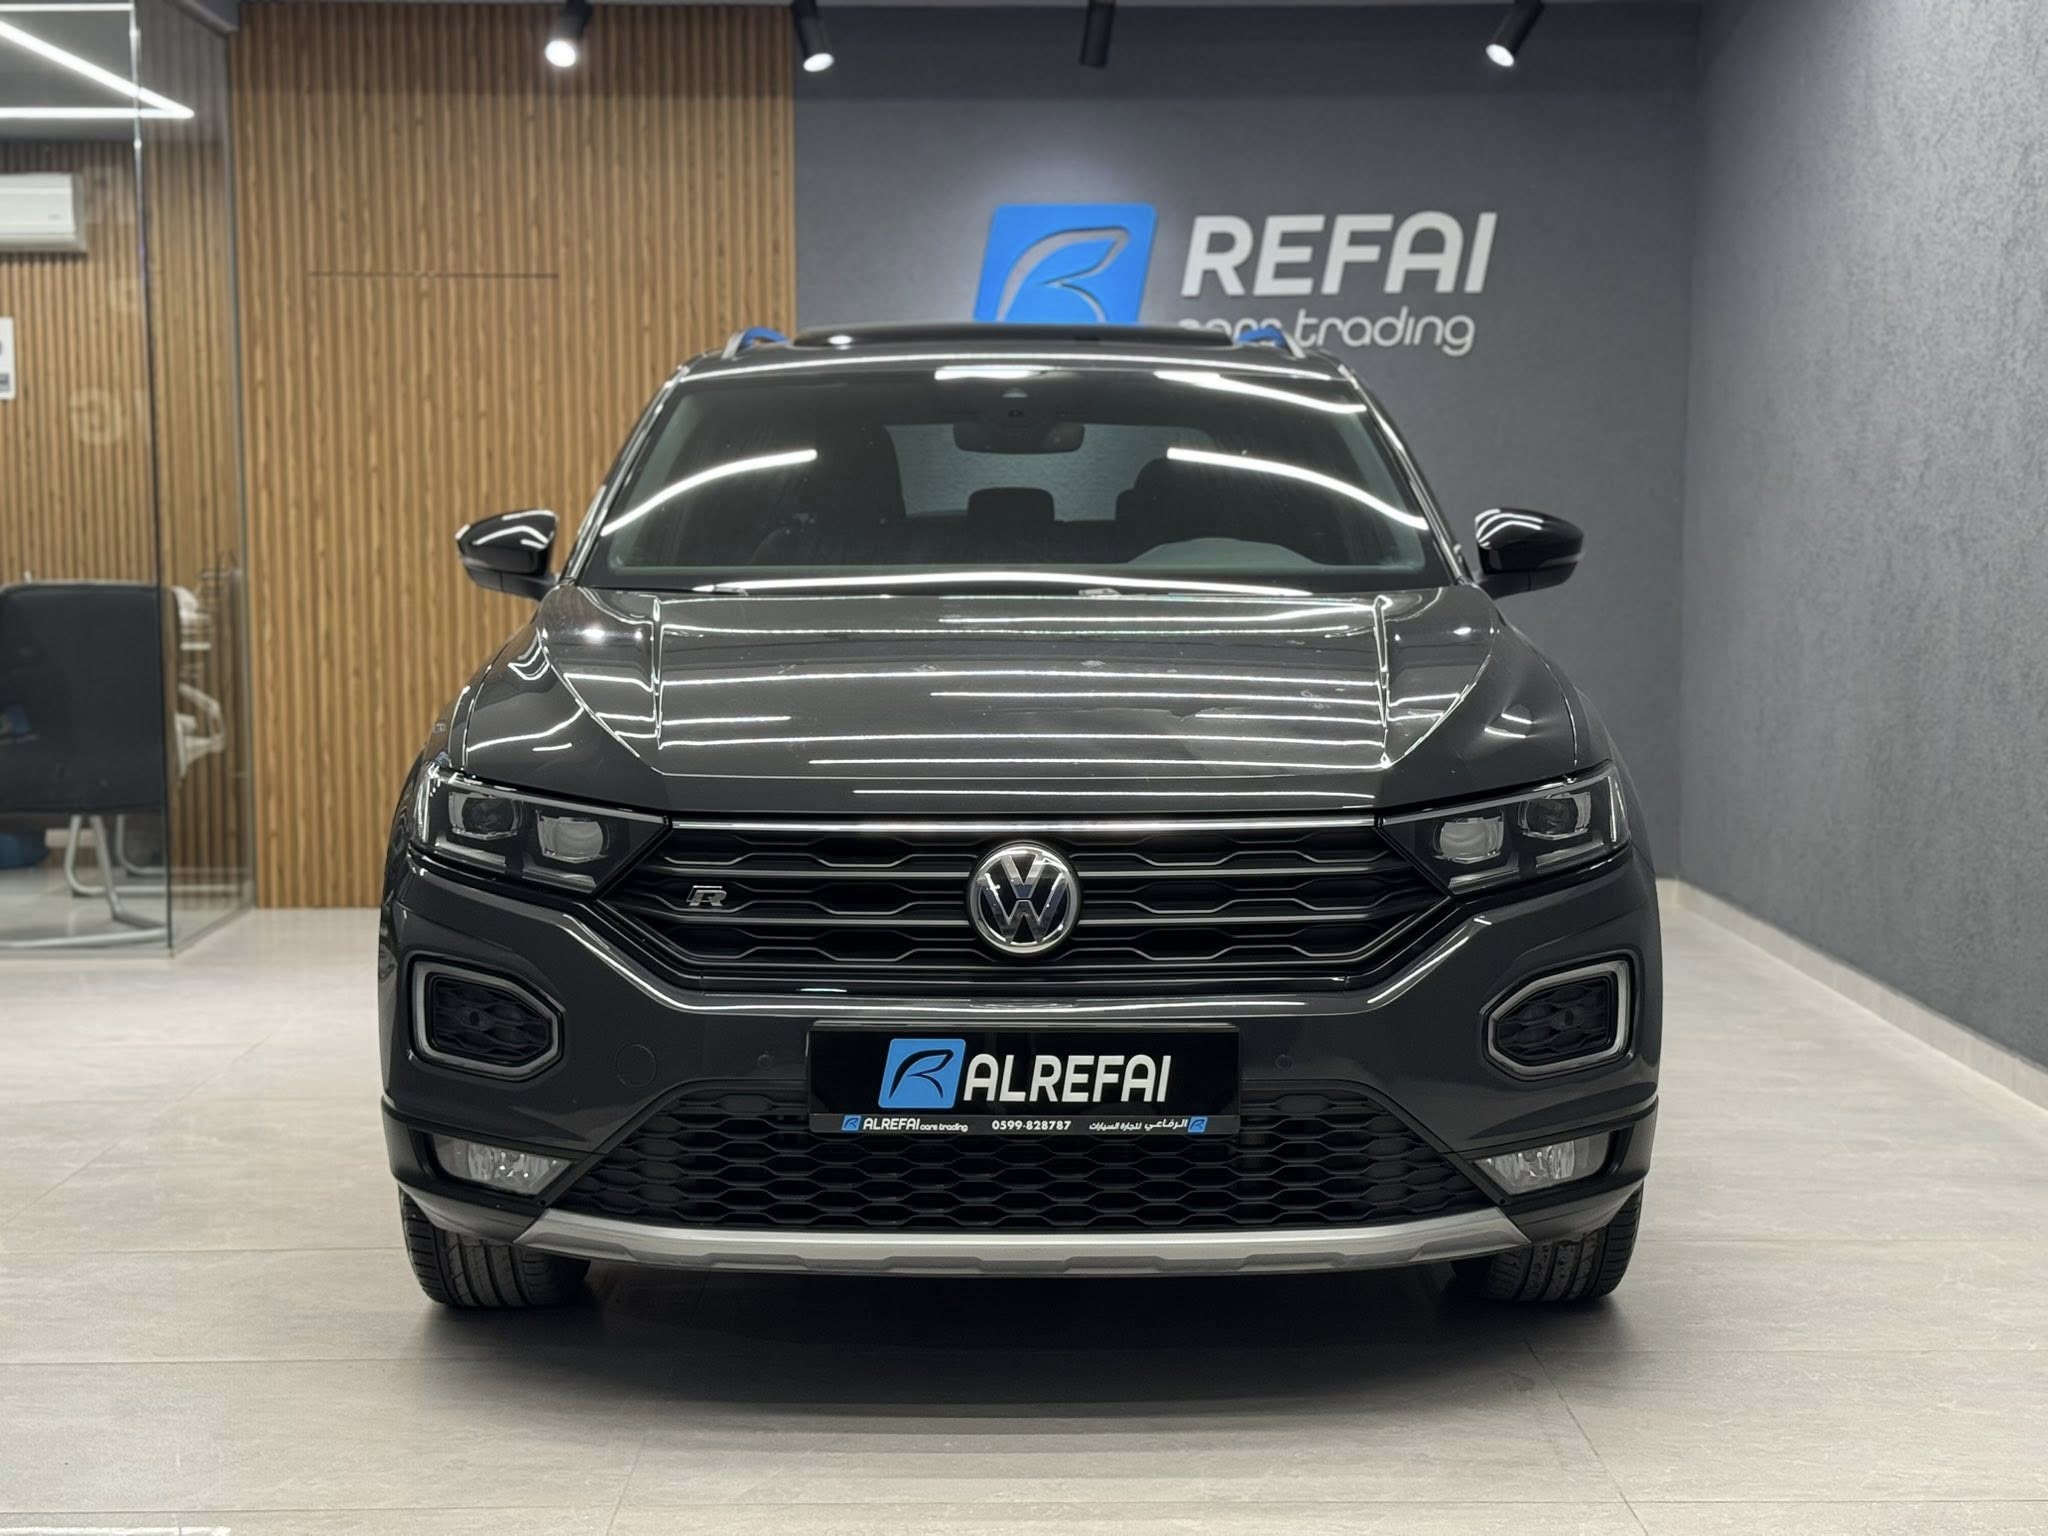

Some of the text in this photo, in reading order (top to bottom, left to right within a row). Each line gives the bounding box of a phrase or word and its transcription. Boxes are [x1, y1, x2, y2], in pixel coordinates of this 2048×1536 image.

[1180, 211, 1498, 297] REFAI
[1294, 306, 1475, 357] trading
[686, 885, 727, 907] R
[963, 1053, 1172, 1102] ALREFAI
[863, 1118, 920, 1130] ALREFAI
[1144, 1118, 1188, 1131] الرفاعي
